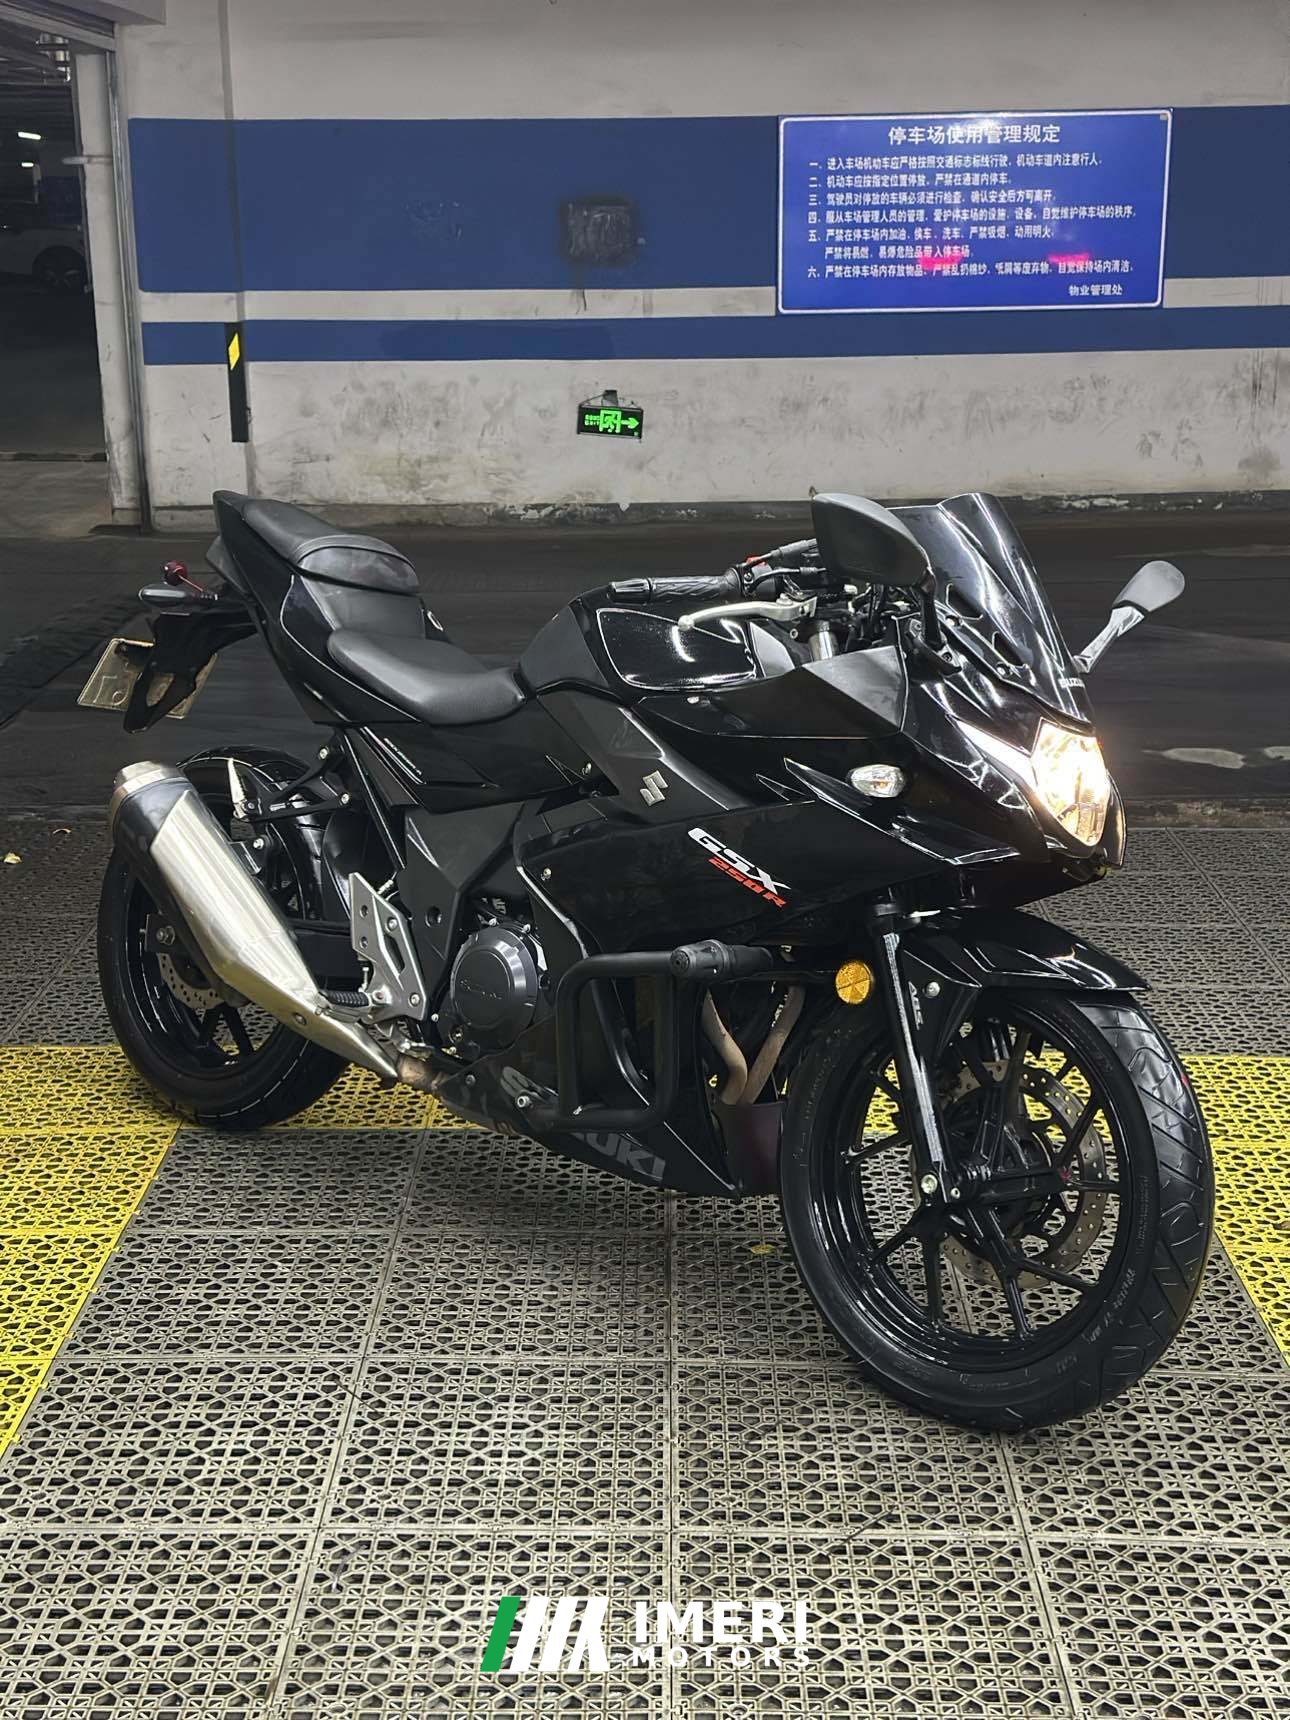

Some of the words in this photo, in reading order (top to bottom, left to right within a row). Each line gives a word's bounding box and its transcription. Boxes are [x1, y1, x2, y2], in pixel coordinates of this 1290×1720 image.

[888, 124, 1061, 145] 停车场使用管理规定
[1069, 284, 1123, 297] 物业管理处
[687, 827, 792, 895] GSX
[708, 856, 787, 908] 250R
